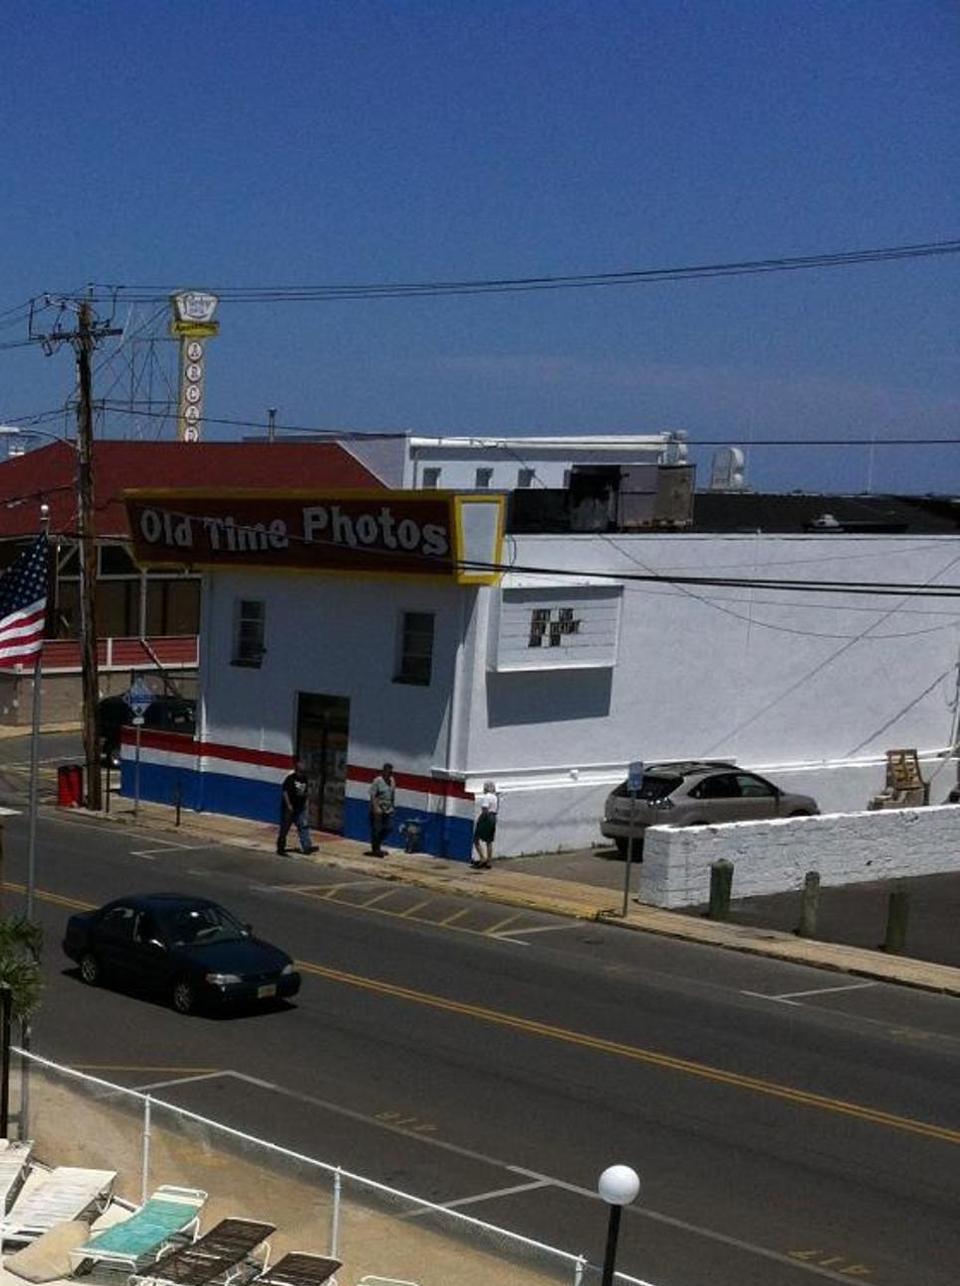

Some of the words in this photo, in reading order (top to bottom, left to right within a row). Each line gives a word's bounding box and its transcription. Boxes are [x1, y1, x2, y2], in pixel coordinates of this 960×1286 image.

[139, 508, 194, 547] Old
[203, 515, 289, 552] Time
[302, 505, 451, 556] Photos
